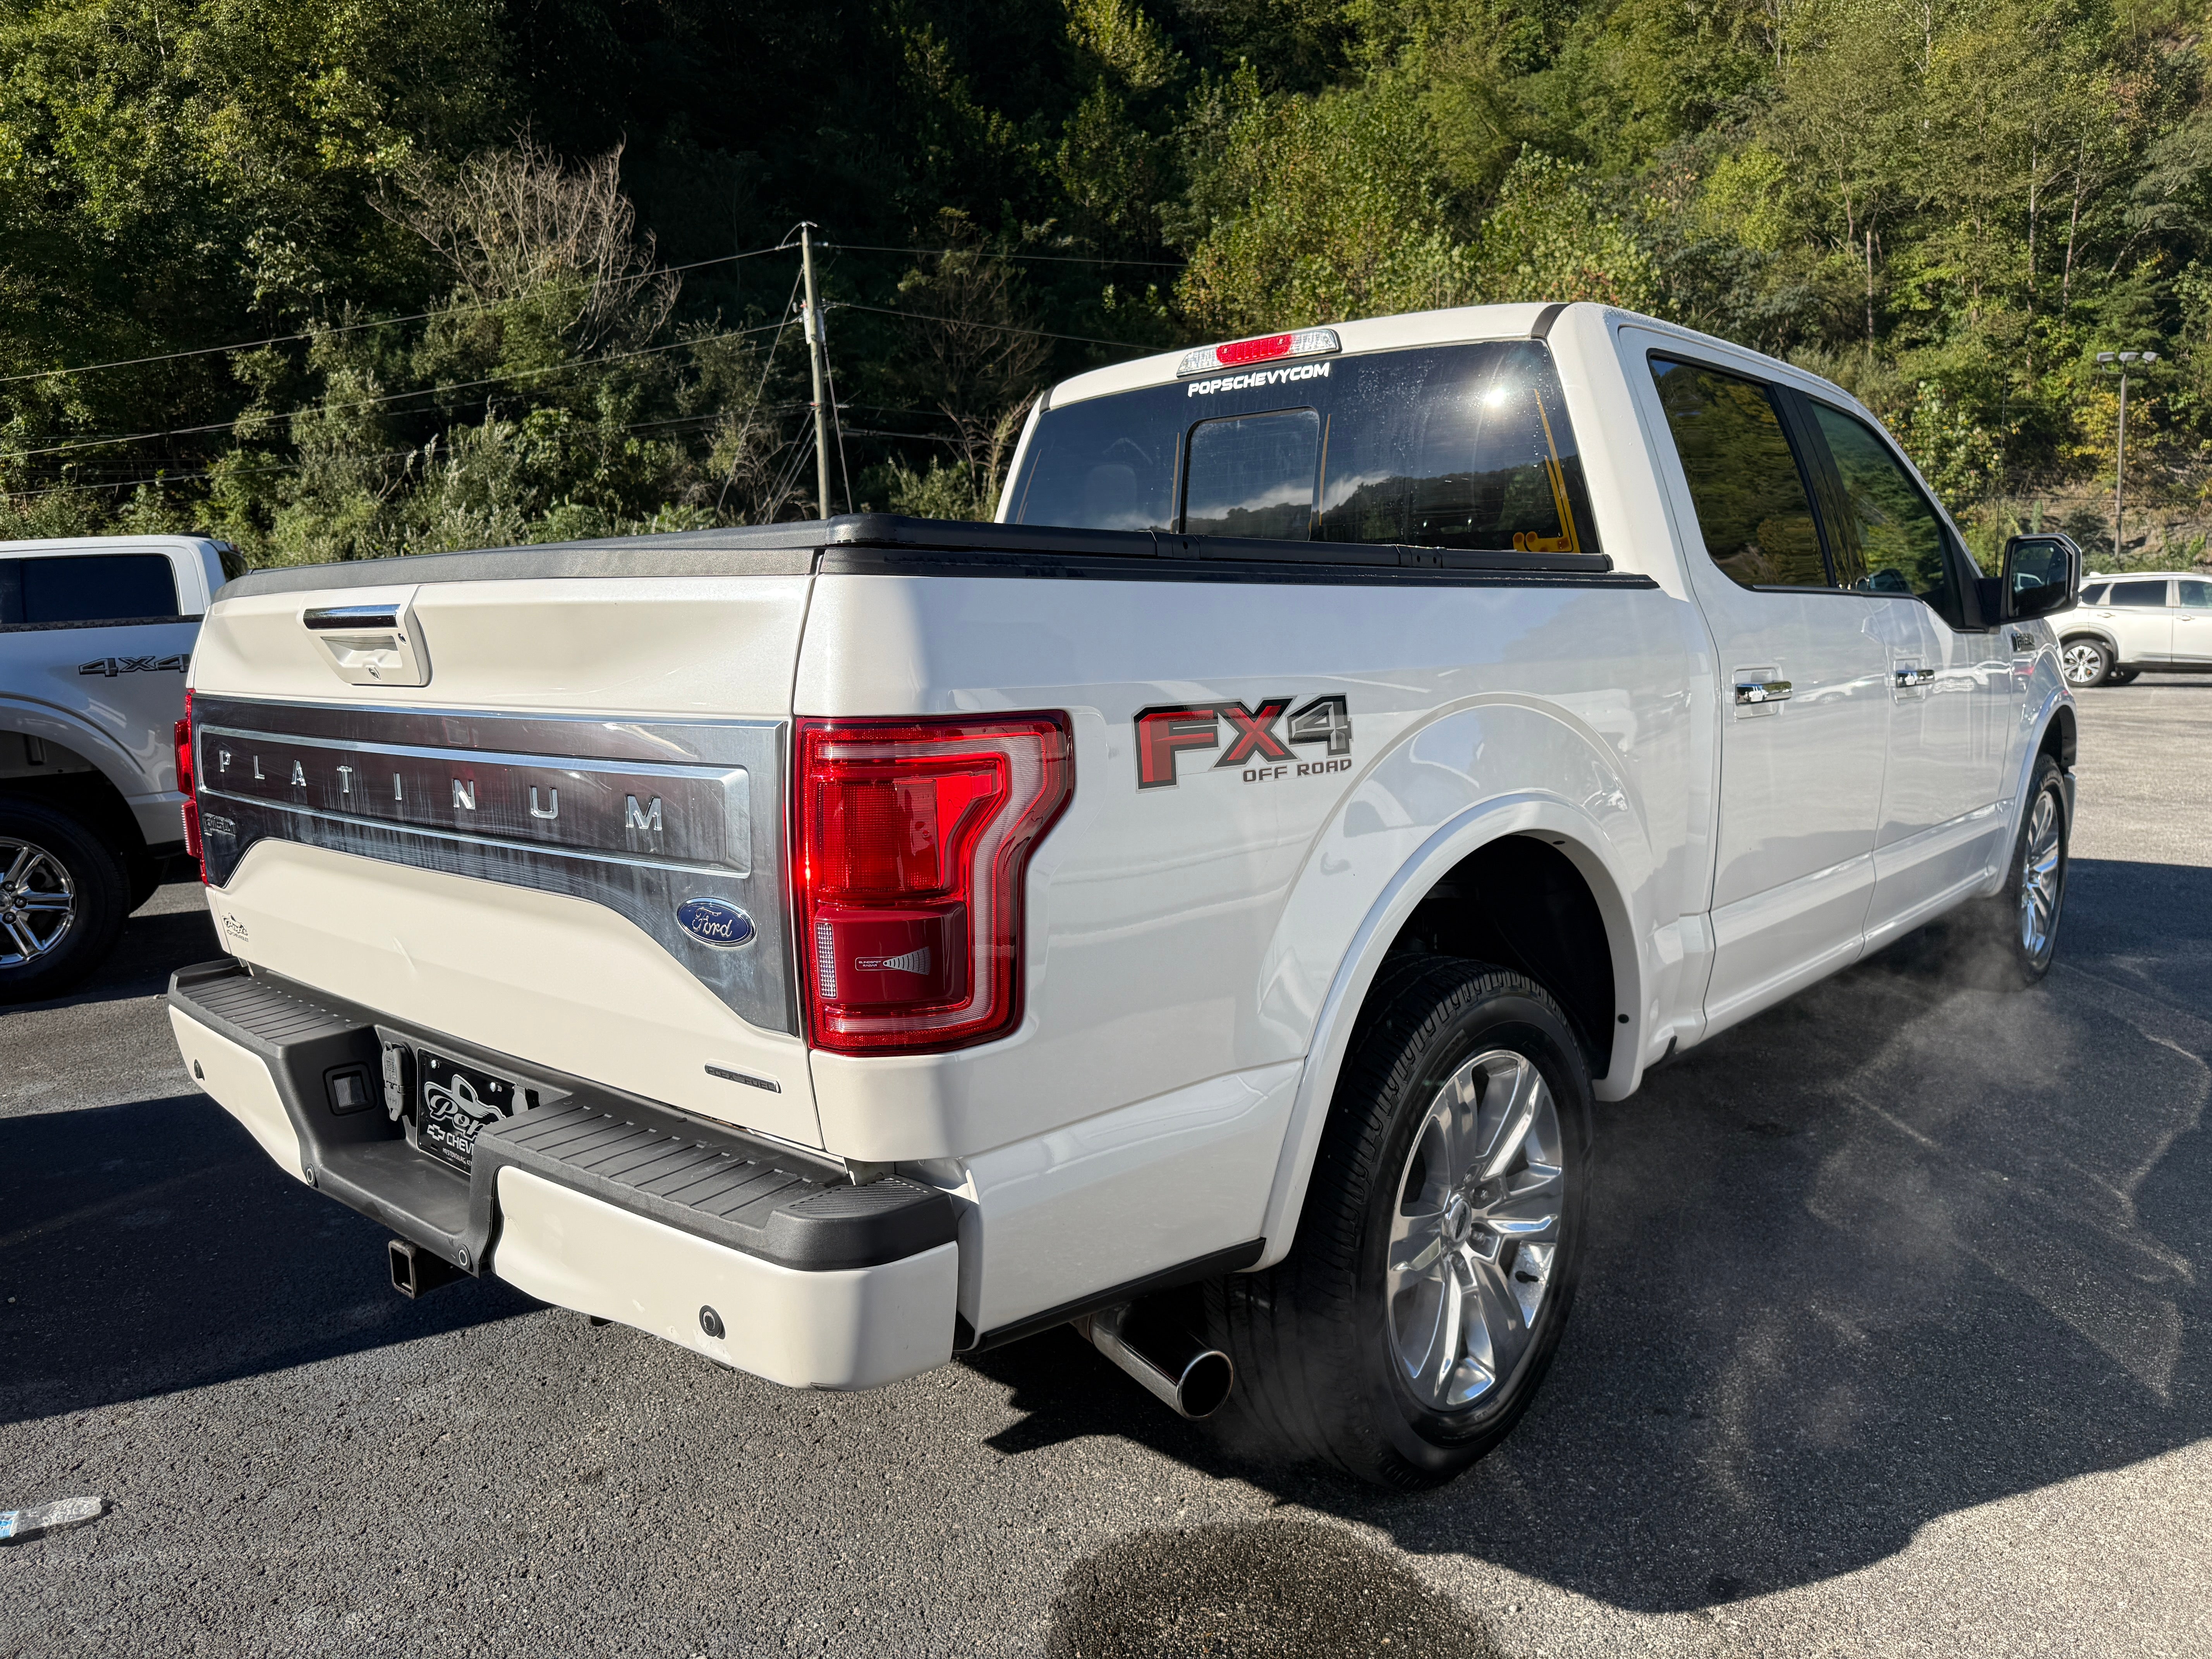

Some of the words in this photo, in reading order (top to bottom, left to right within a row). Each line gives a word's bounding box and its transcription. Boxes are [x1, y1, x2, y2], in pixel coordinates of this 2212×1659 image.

[79, 654, 189, 677] 4X4
[1132, 693, 1352, 792] FX4
[1243, 766, 1287, 782] OFF
[1297, 759, 1352, 776] ROAD
[219, 749, 663, 831] PLATINUM
[692, 907, 733, 938] Ford
[708, 1067, 735, 1080] FLEX
[744, 1077, 775, 1092] FUEL
[430, 1095, 485, 1135] Pop
